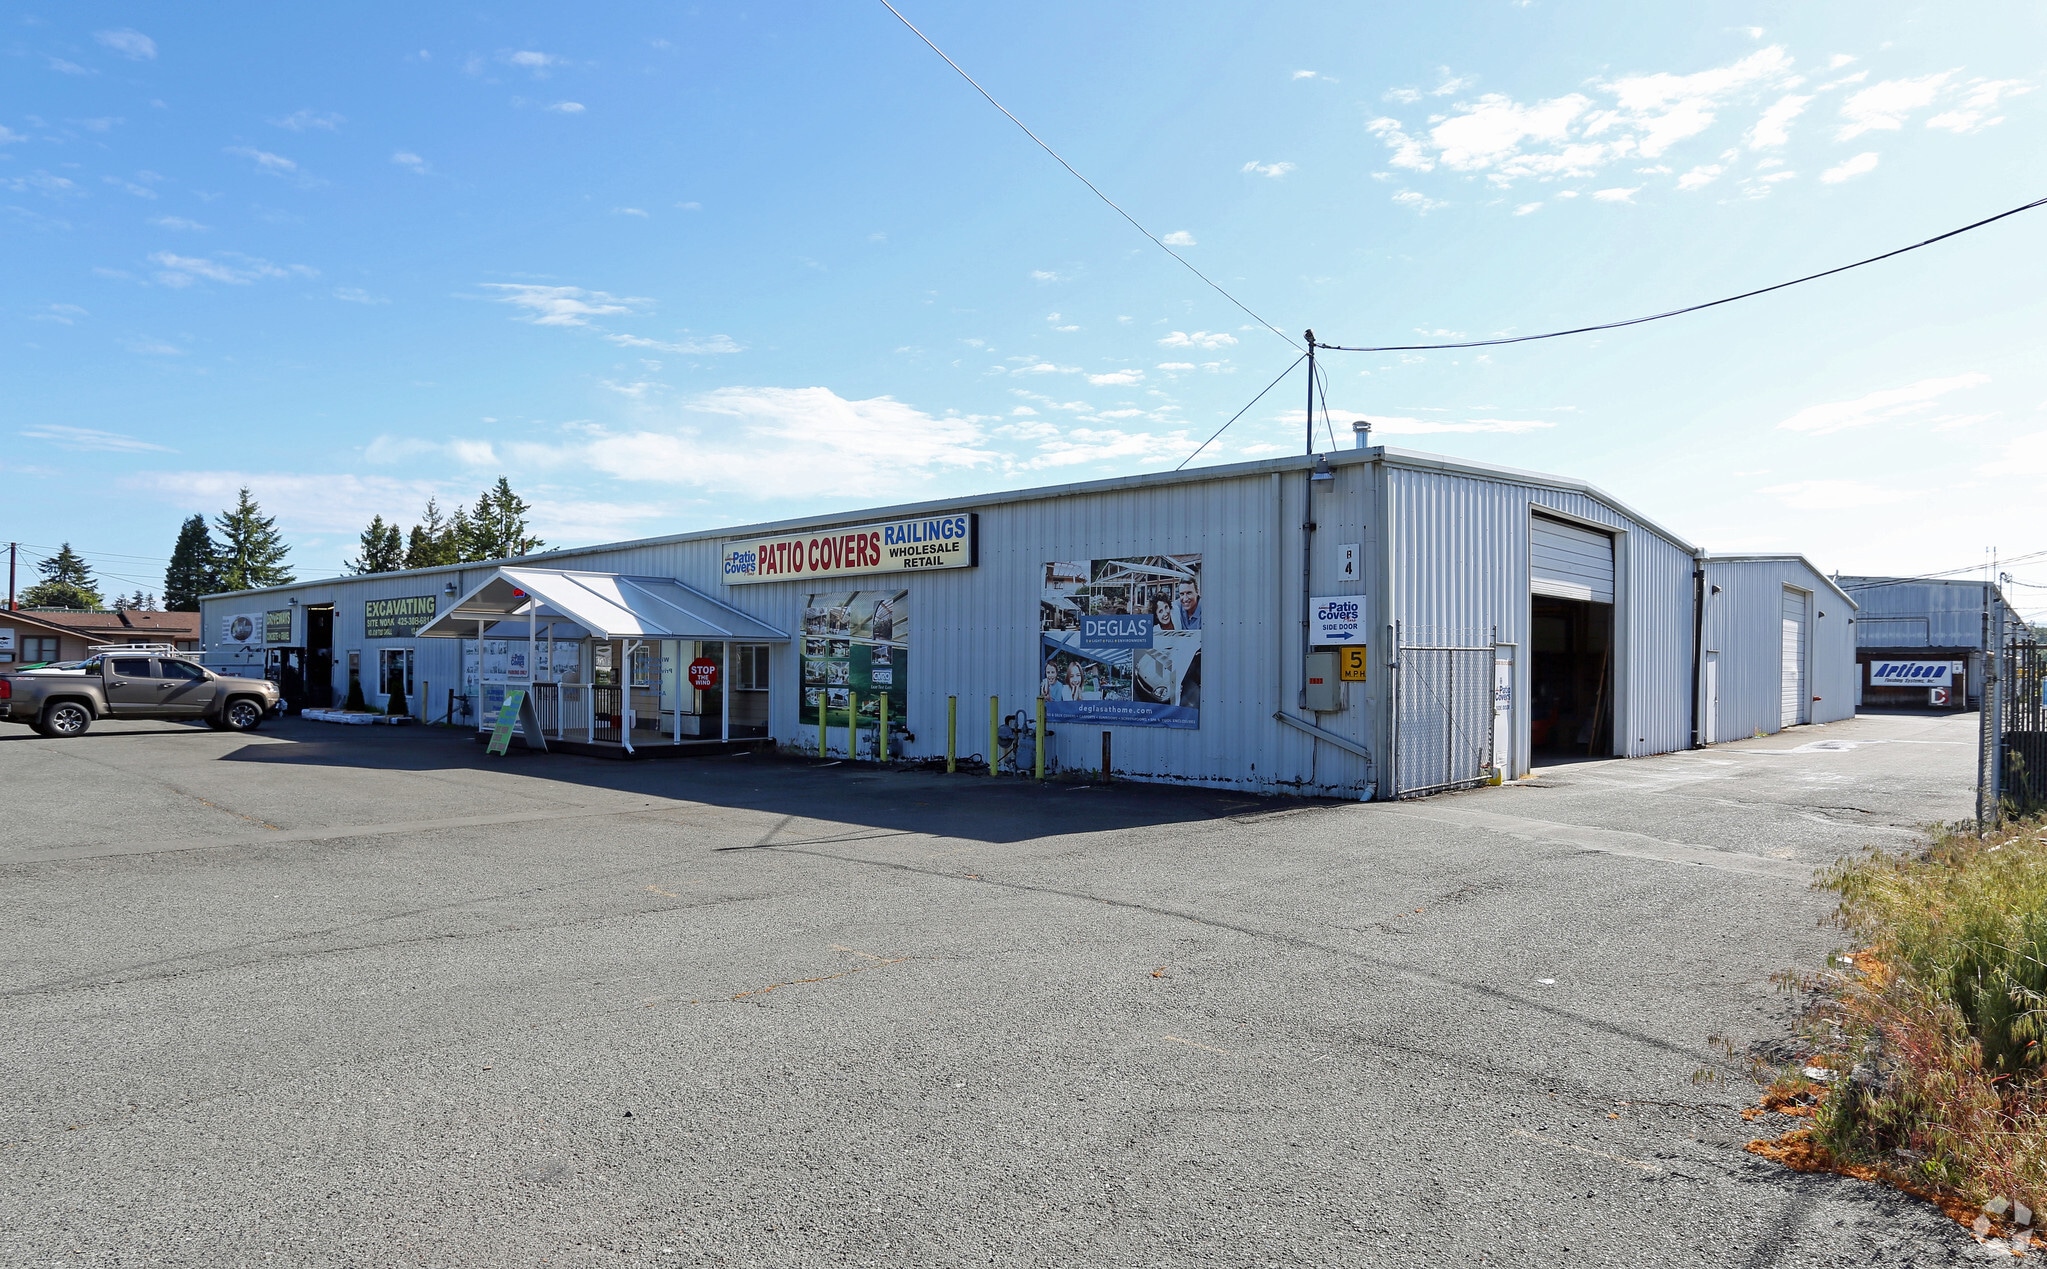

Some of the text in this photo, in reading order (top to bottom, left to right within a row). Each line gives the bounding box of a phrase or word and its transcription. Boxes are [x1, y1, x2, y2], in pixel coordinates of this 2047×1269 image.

[885, 518, 966, 545] RAILINGS
[758, 531, 881, 576] PATIO COVERS
[889, 542, 960, 558] WHOLESALE
[733, 550, 756, 564] Patio
[904, 556, 944, 568] RETAIL
[724, 562, 756, 575] Covers
[1345, 562, 1352, 574] 4
[366, 597, 435, 617] EXCAVATING
[1329, 601, 1358, 612] Patio
[1318, 609, 1358, 620] Covers
[367, 619, 378, 628] SITE
[1086, 619, 1147, 637] DEGLAS
[1350, 651, 1363, 668] 5
[691, 665, 716, 674] STOP
[1873, 663, 1947, 678] Artisan
[1078, 704, 1153, 714] deglasathome.com
